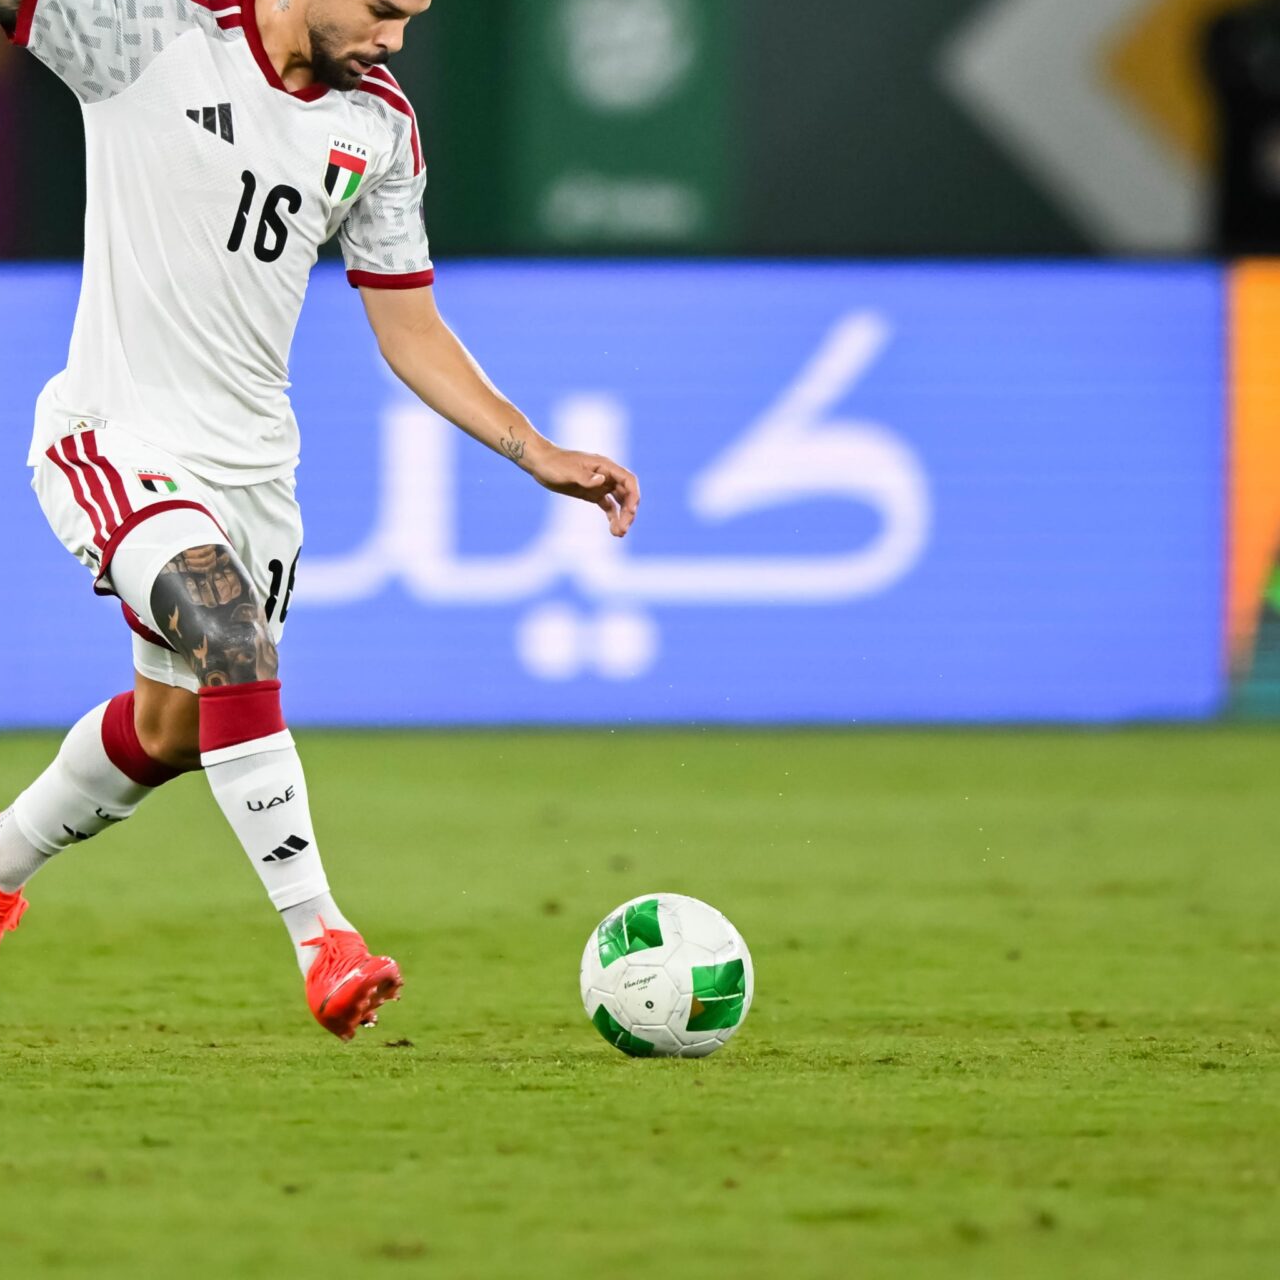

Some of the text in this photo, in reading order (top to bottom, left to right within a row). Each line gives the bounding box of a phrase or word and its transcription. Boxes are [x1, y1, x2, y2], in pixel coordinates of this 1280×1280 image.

[333, 139, 353, 152] UAE
[226, 169, 302, 263] 16
[246, 784, 296, 812] UAE
